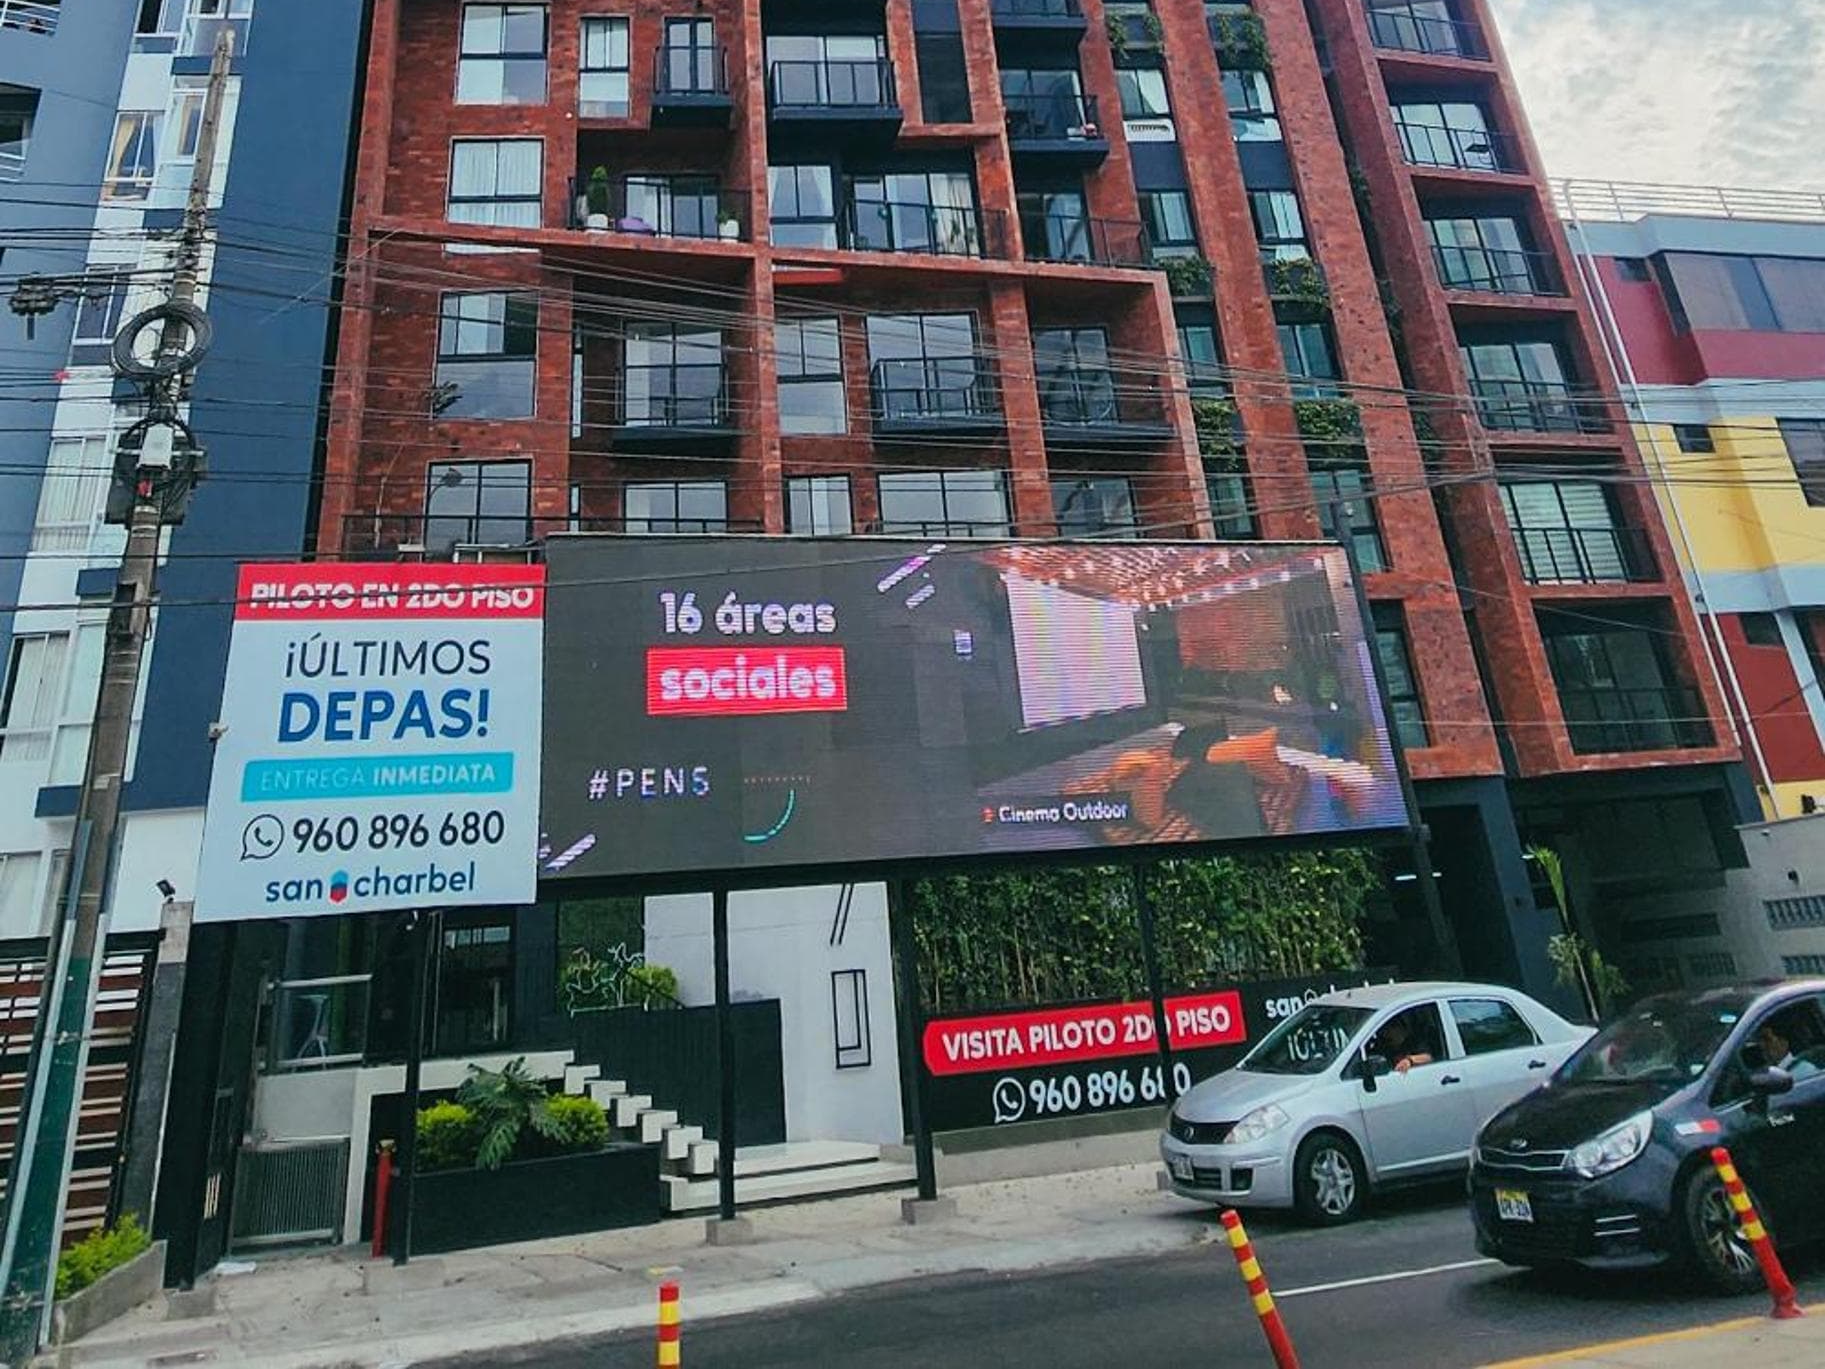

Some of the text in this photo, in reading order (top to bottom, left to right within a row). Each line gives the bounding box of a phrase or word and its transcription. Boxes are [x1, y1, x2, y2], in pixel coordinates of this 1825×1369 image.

[250, 583, 535, 609] PILOTO EN 2DO PISO
[659, 591, 837, 635] 16 áreas
[285, 632, 491, 677] ¡ÚLTIMOS
[659, 654, 837, 701] sociales
[277, 687, 490, 742] DEPAS!
[261, 762, 496, 792] ENTREGA INMEDIATA
[292, 810, 505, 853] 960 896 680
[998, 800, 1129, 823] Cinema Outdoor
[265, 861, 476, 903] san charbel
[1264, 996, 1304, 1019] san
[942, 1028, 1025, 1062] VISITA
[1029, 1018, 1116, 1053] PILOTO
[1175, 1005, 1231, 1038] PISO
[1028, 1075, 1082, 1114] 960
[1086, 1069, 1136, 1108] 896
